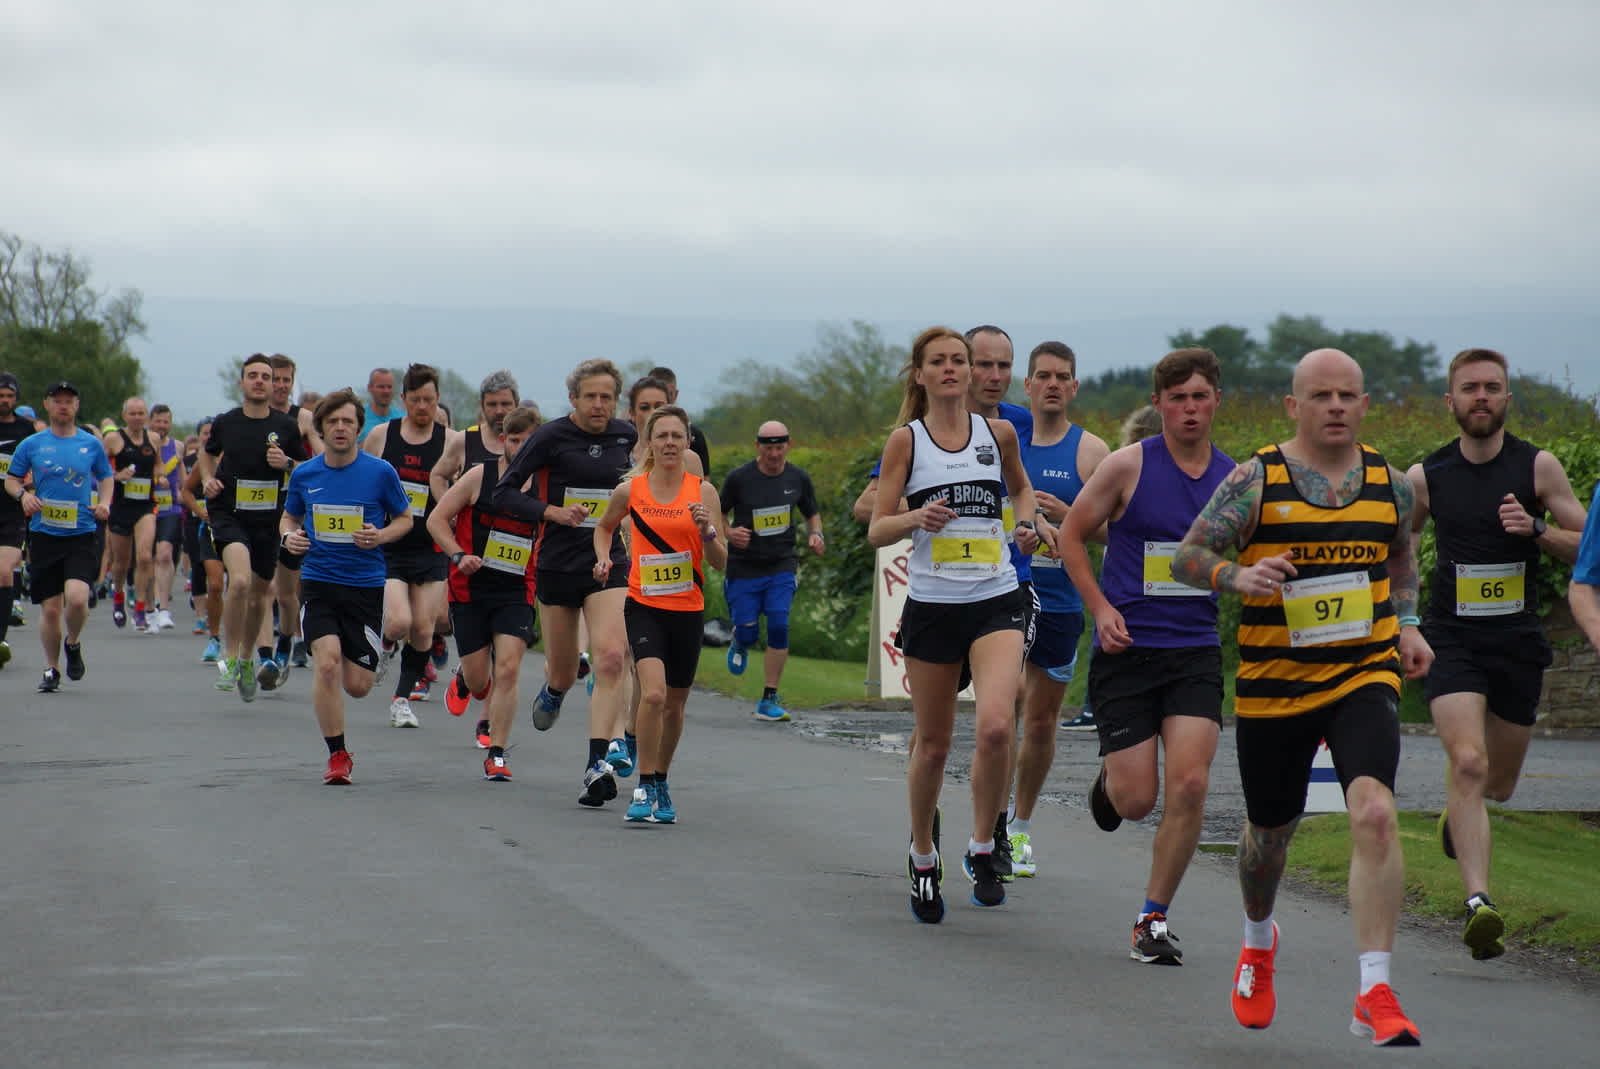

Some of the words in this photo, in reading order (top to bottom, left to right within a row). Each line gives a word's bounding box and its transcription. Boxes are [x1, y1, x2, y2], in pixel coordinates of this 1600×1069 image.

[250, 490, 265, 501] 75
[49, 508, 69, 520] 124
[641, 508, 684, 516] BORDER
[328, 517, 345, 530] 31
[763, 515, 784, 528] 121
[496, 546, 521, 562] 110
[961, 542, 973, 559] 1
[1290, 544, 1378, 561] BLAYDON
[653, 566, 681, 582] 119
[1480, 581, 1505, 599] 66
[1314, 596, 1344, 621] 97
